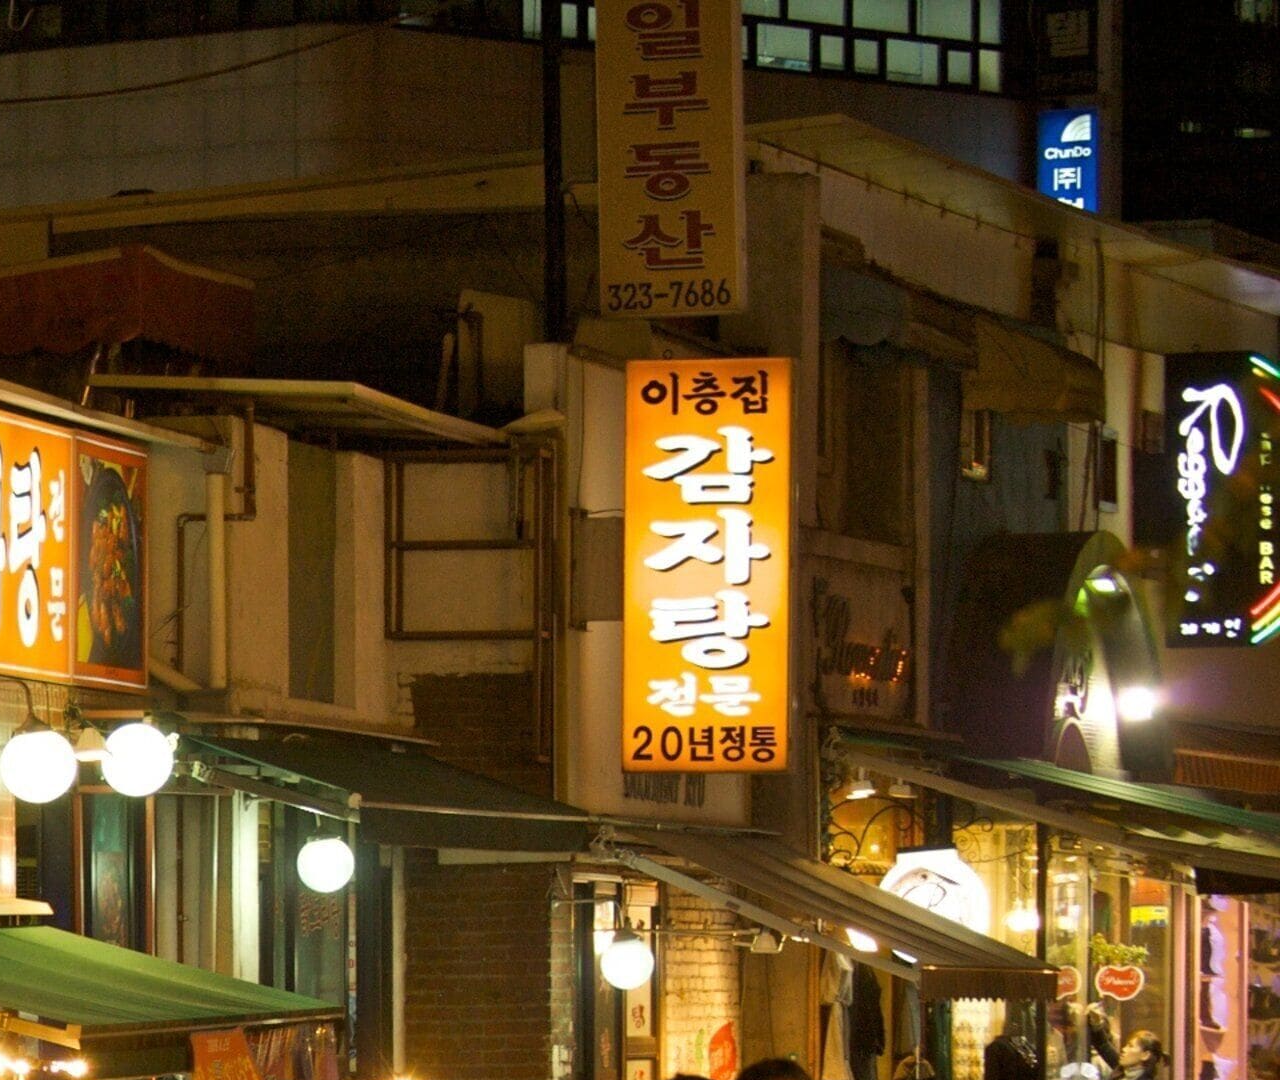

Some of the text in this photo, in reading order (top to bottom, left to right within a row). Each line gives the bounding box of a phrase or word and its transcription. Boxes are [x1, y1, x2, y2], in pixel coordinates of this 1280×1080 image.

[607, 277, 732, 314] 323-7686
[640, 369, 771, 417] 이층집
[47, 468, 67, 642] 전문
[643, 425, 775, 670] 감자탕
[1259, 540, 1275, 585] BAR
[646, 671, 762, 718] 전문
[632, 725, 778, 763] 20년정통
